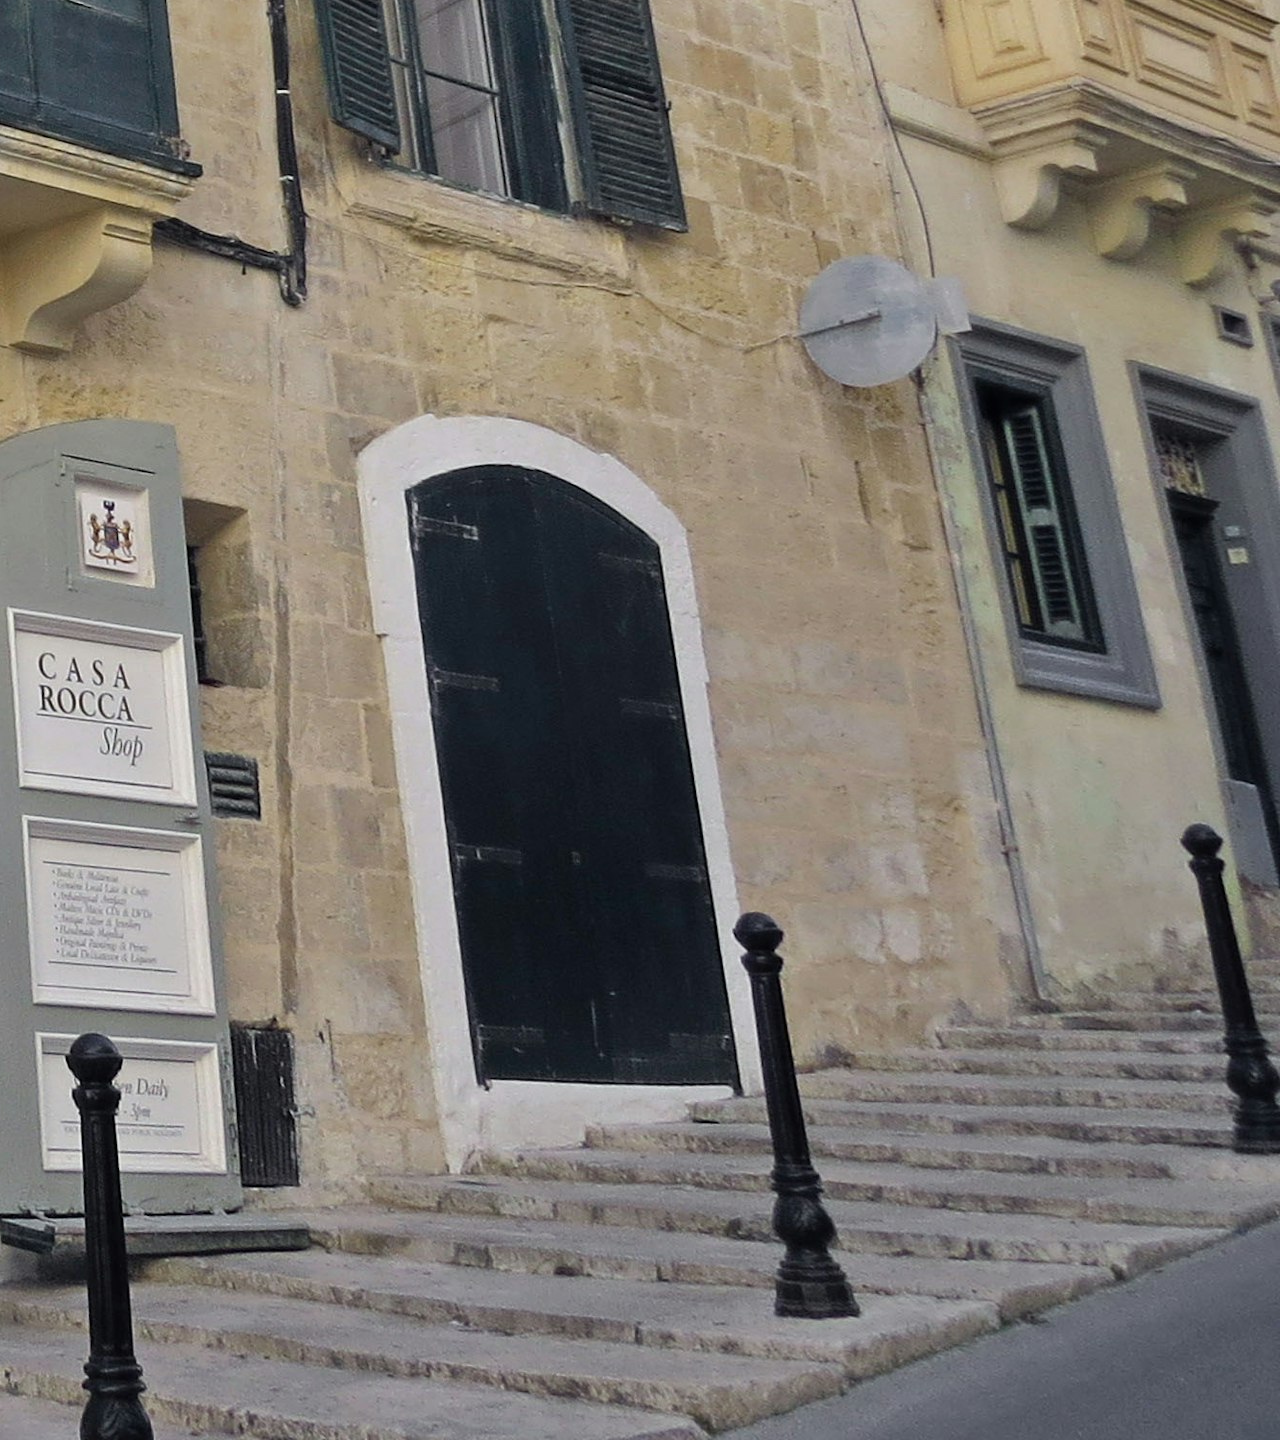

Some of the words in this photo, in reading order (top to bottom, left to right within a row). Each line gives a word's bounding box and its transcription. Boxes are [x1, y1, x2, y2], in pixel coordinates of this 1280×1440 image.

[38, 652, 131, 690] CASA
[39, 684, 135, 722] ROCCA
[100, 727, 143, 766] Shop
[137, 1078, 168, 1100] Daily
